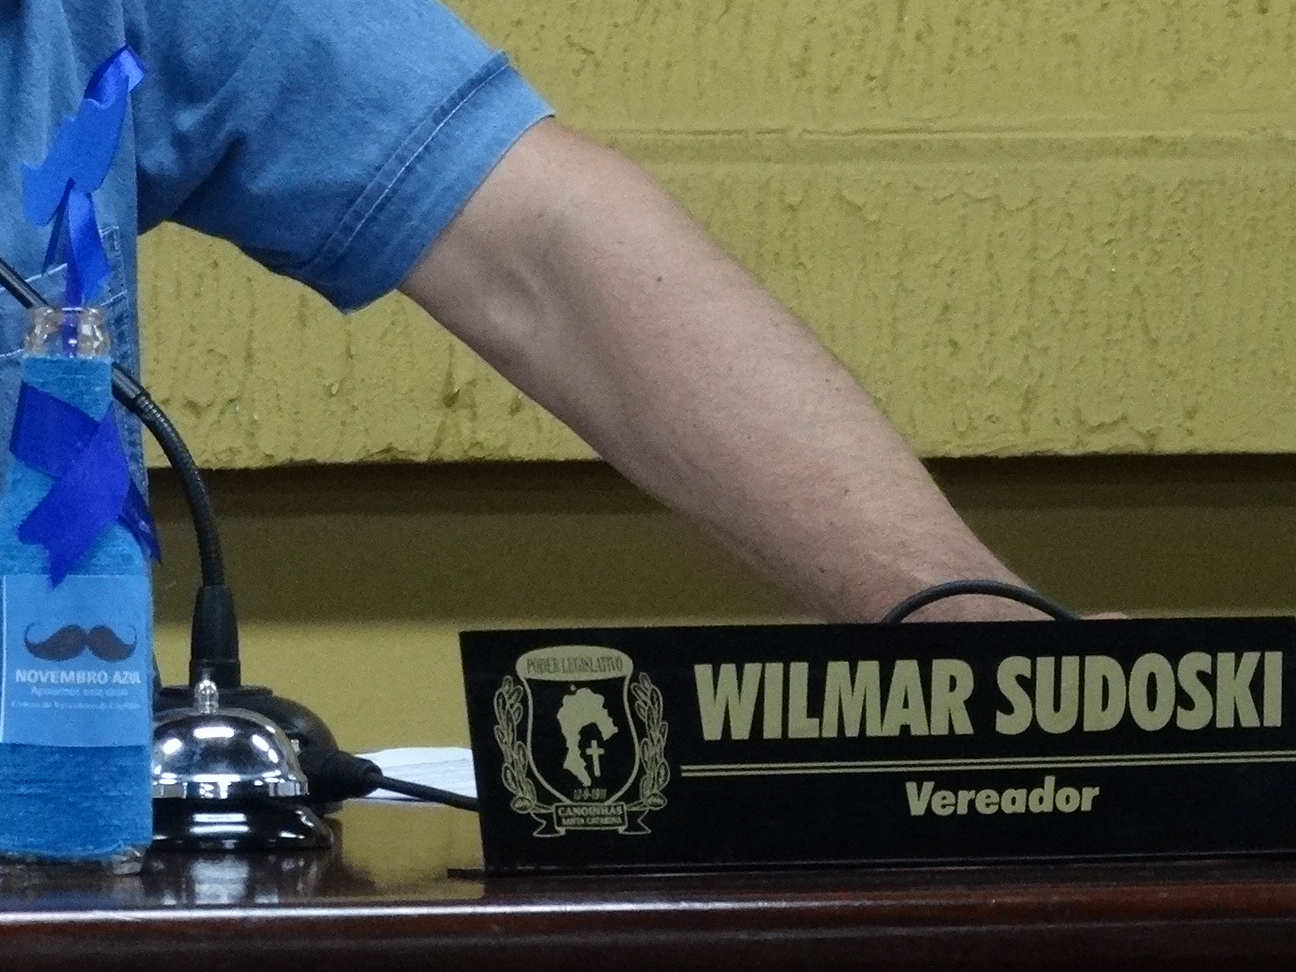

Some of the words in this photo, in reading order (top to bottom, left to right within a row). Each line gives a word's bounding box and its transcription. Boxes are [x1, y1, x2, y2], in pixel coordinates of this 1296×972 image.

[15, 668, 109, 685] NOVEMBRO
[112, 670, 142, 685] AZUL
[694, 659, 974, 741] WILMAR
[996, 651, 1283, 735] SUDOSKI
[905, 775, 1100, 816] Vereador
